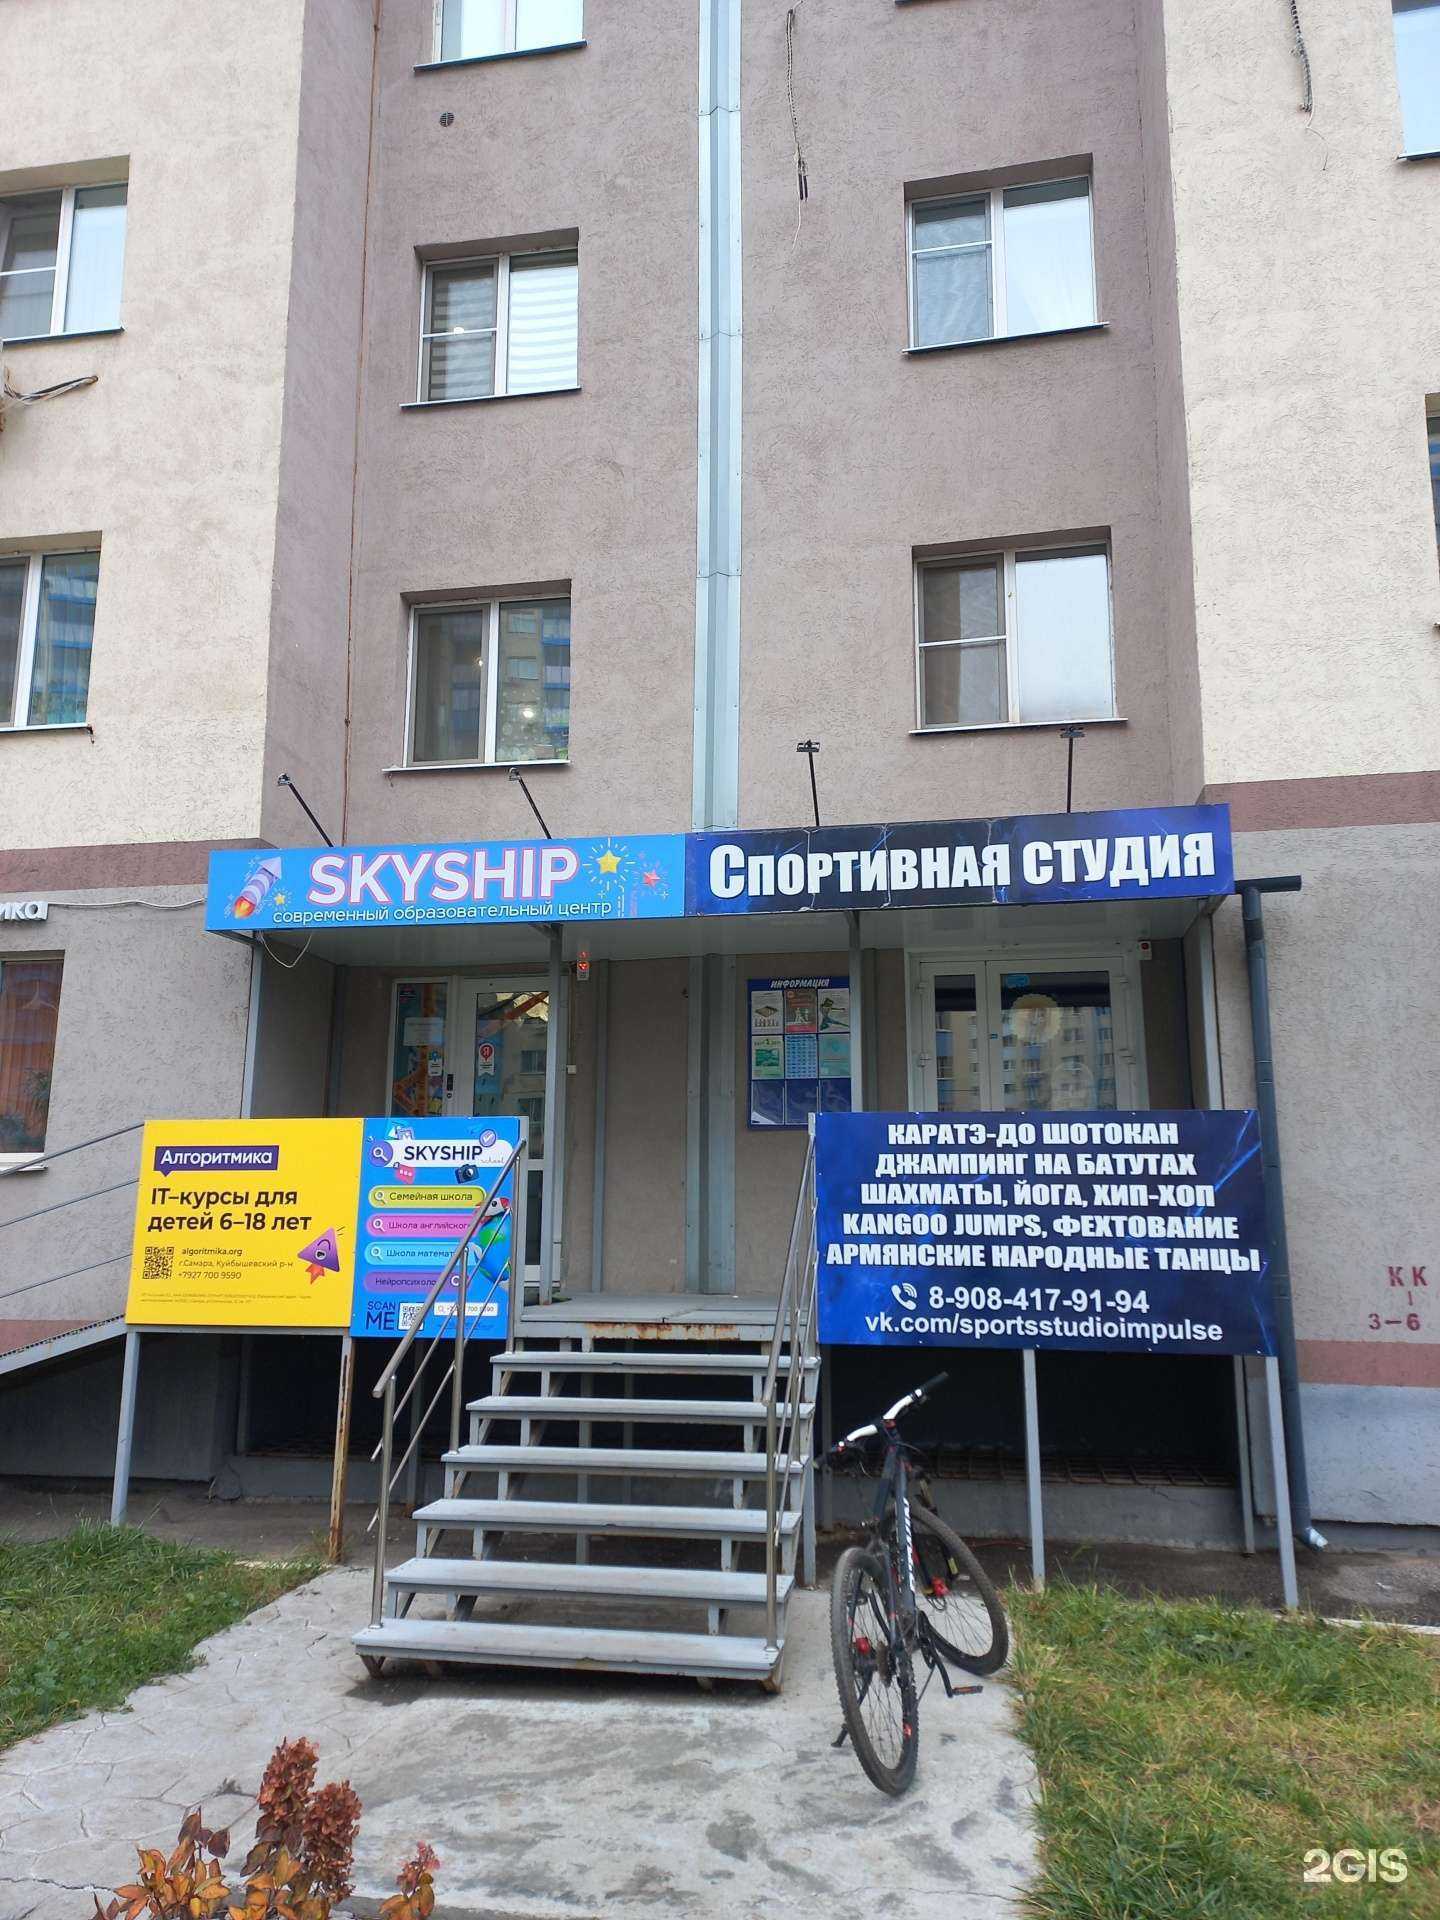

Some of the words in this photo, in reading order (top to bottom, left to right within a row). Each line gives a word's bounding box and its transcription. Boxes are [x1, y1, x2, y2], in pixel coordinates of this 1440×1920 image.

[308, 846, 580, 906] SKYSHIP
[272, 905, 389, 925] современный
[393, 900, 555, 922] образовательный
[558, 900, 612, 919] центр
[770, 978, 830, 989] ИНФОРМАЦИЯ
[887, 1123, 1036, 1148] КАРАТЭ-ДО
[1043, 1123, 1179, 1145] ШОТОКАН
[160, 1149, 273, 1167] Алгоритмика
[404, 1145, 483, 1161] SKYSHIP
[875, 1153, 1028, 1178] ДЖАМПИНГ
[1035, 1154, 1071, 1175] НА
[1077, 1153, 1197, 1176] БАТУТАХ
[254, 1190, 298, 1207] для
[389, 1191, 439, 1201] Семейная
[440, 1193, 473, 1201] школа
[860, 1183, 1008, 1208] ШАХМАТЫ,
[1012, 1179, 1089, 1208] ЙОГА,
[1093, 1184, 1216, 1207] ХИП-ХОП
[147, 1211, 213, 1232] детей
[271, 1216, 312, 1231] лет
[388, 1221, 418, 1230] Школа
[420, 1222, 470, 1231] английског
[843, 1213, 948, 1236] KANGOO
[953, 1214, 1048, 1239] JUMPS,
[1053, 1214, 1239, 1240] ФЕХТОВАНИЕ
[181, 1247, 243, 1258] algoritmika.org
[386, 1248, 416, 1257] Школа
[417, 1250, 455, 1258] математ
[826, 1243, 986, 1268] АРМЯНСКИЕ
[992, 1245, 1149, 1272] НАРОДНЫЕ
[1154, 1247, 1261, 1275] ТАНЦЫ
[203, 1271, 219, 1279] 700
[375, 1278, 438, 1288] Нейропсихоло
[367, 1301, 396, 1310] SCAN
[928, 1286, 1150, 1314] 8-908-417-91-94
[366, 1311, 395, 1331] ME
[865, 1311, 1223, 1342] vk.com/sportsstudioimpulse
